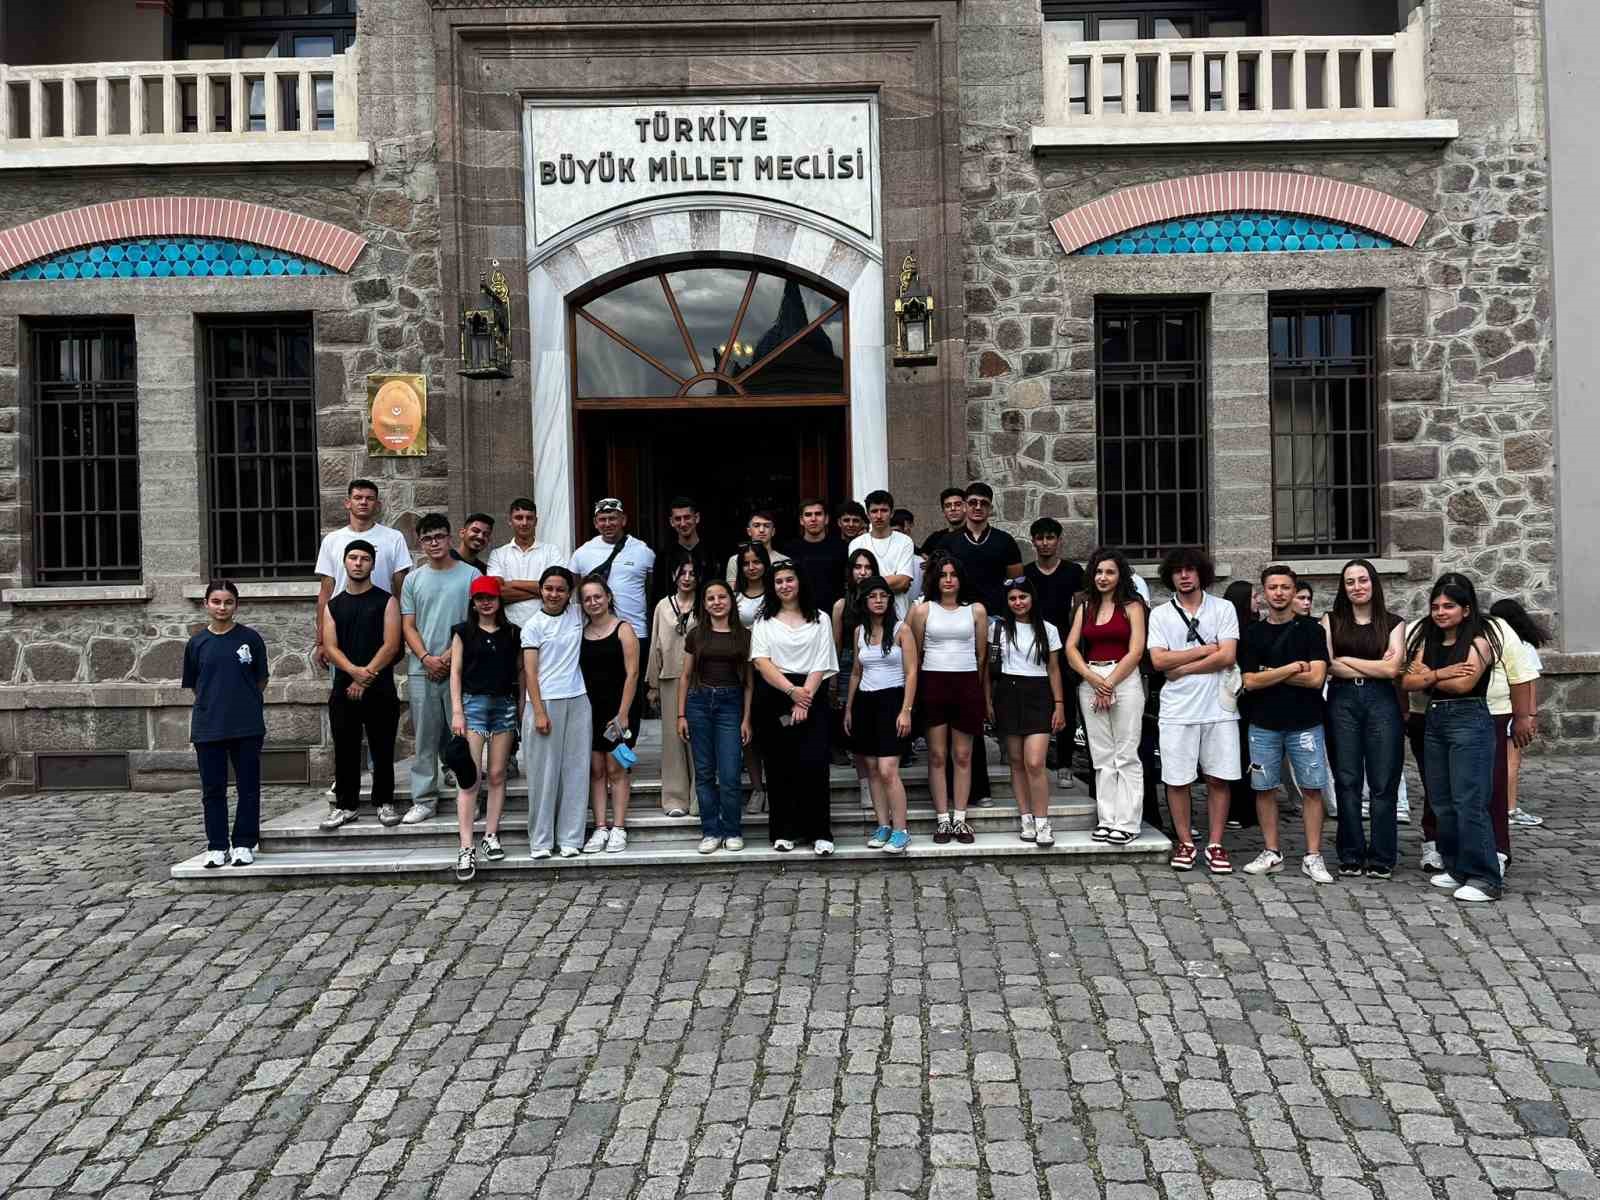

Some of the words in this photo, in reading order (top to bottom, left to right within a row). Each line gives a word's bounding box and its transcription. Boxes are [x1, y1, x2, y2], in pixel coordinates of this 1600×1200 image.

[635, 110, 767, 143] TÜRKİYE
[540, 152, 635, 185] BÜYÜK
[649, 150, 743, 182] MİLLET
[755, 147, 864, 180] MECLİSİ
